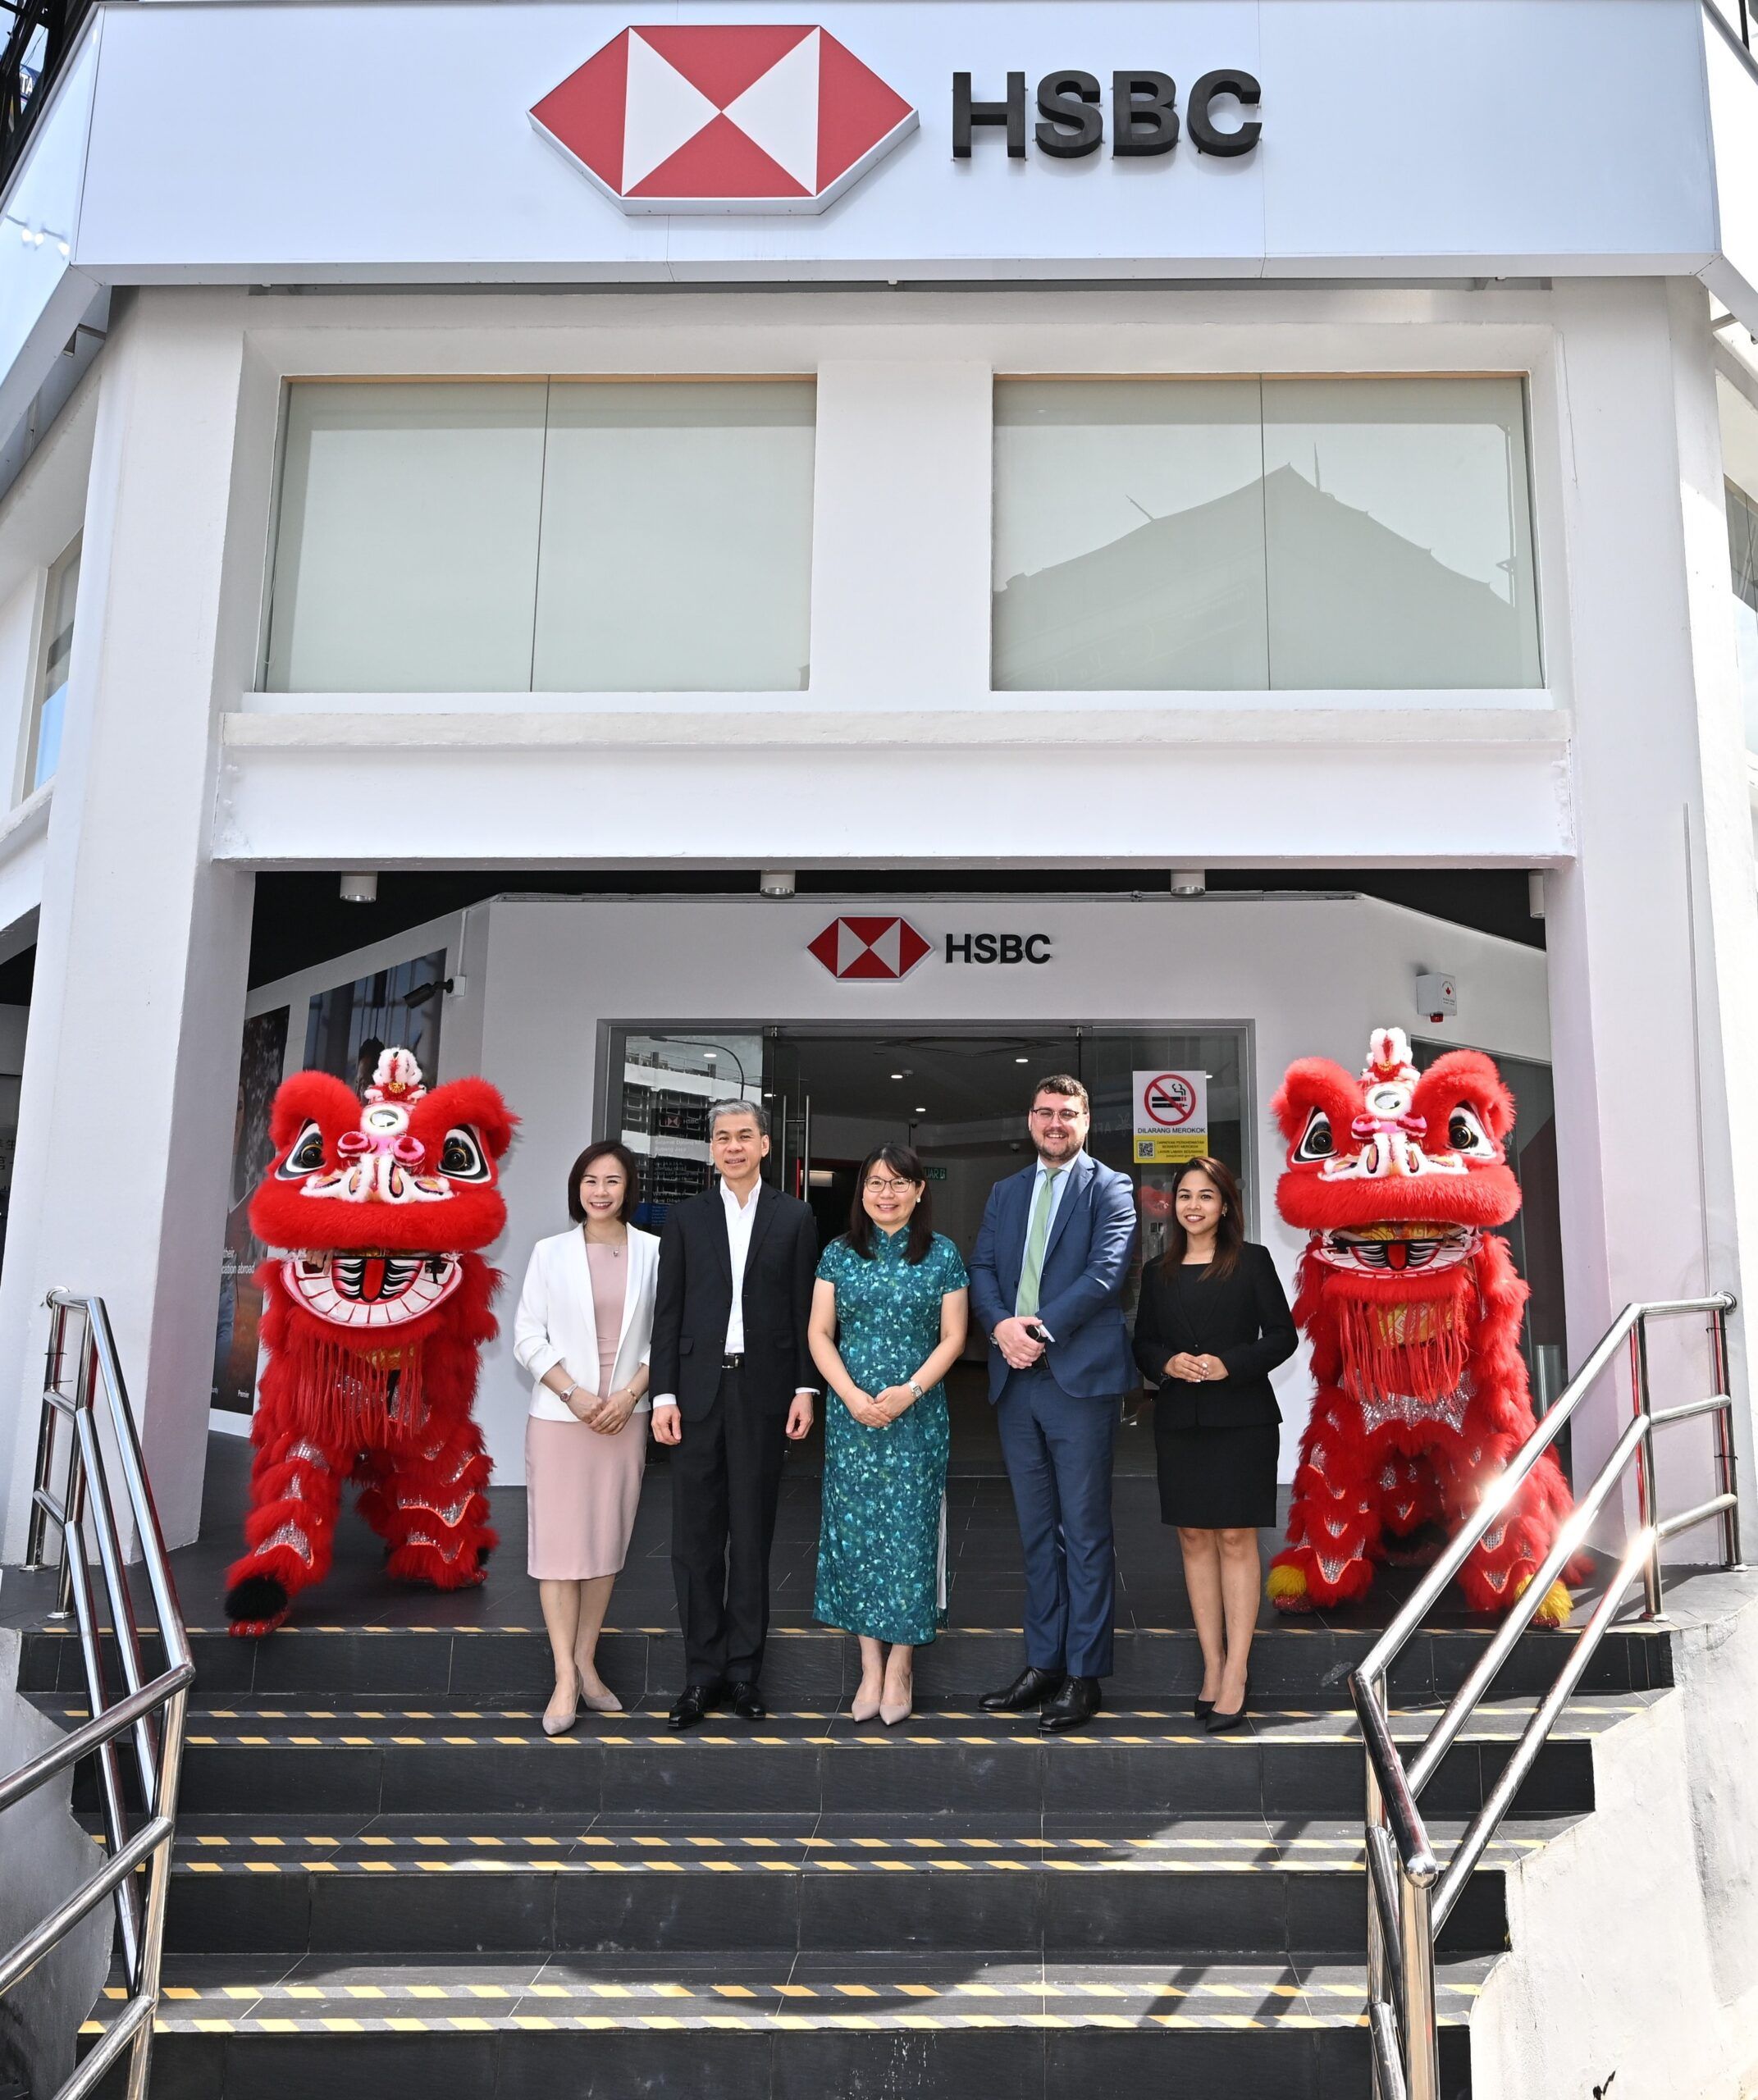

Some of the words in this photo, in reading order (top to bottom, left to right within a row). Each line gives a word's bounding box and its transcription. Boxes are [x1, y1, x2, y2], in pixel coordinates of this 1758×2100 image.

[952, 69, 1263, 158] HSBC
[946, 934, 1051, 964] HSBC
[925, 1168, 939, 1179] UAR
[221, 1262, 236, 1274] cation
[237, 1262, 255, 1274] abroad
